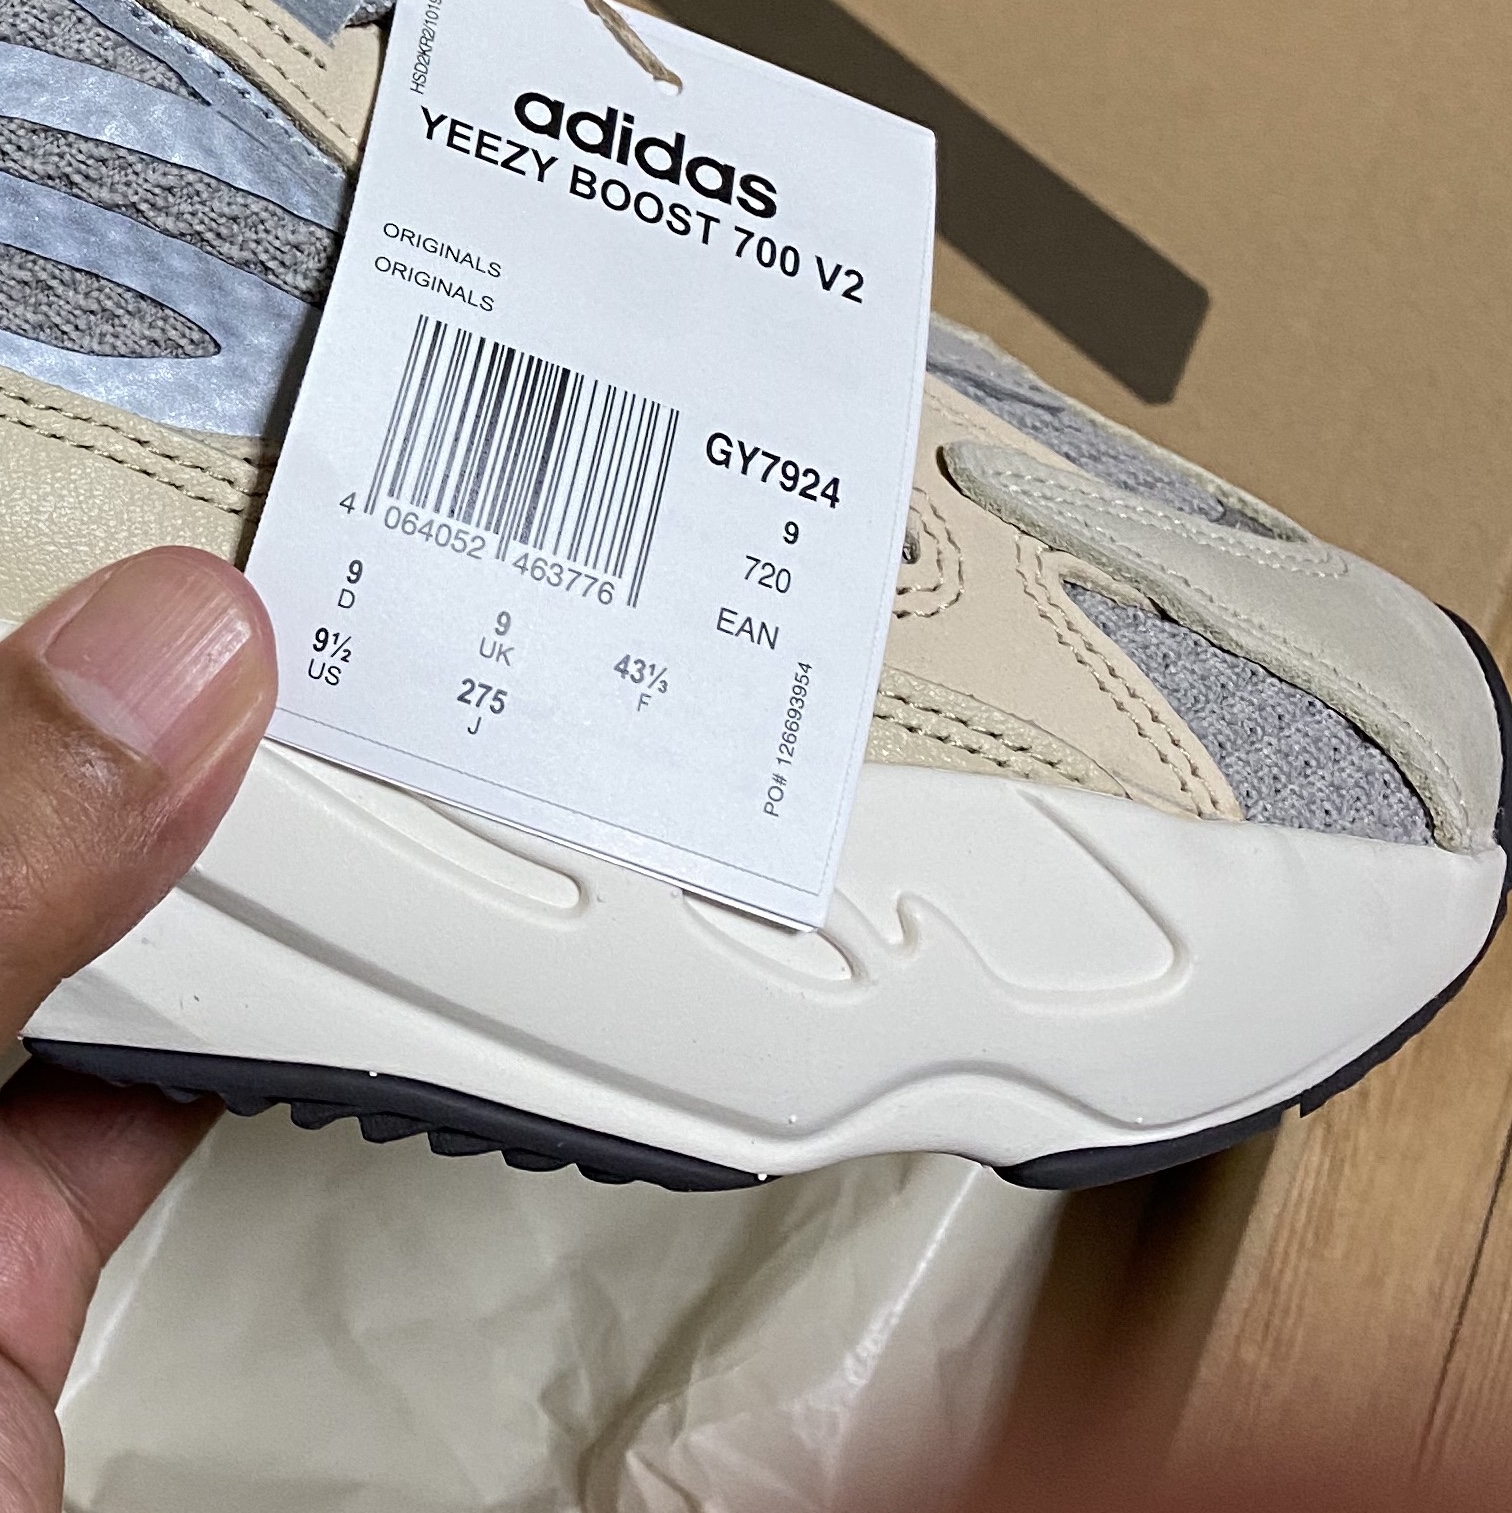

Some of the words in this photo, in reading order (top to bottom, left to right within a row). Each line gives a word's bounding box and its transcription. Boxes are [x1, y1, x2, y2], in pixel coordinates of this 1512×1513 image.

[513, 91, 778, 219] adidas
[420, 104, 560, 184] YEEZY
[568, 163, 721, 246] BOOST
[734, 225, 801, 278] 700
[814, 254, 865, 305] V2
[382, 222, 502, 279] ORIGINALS
[374, 255, 495, 312] ORIGINALS
[705, 431, 841, 510] GY7924
[338, 491, 357, 515] 4
[383, 505, 486, 560] 064052
[511, 552, 616, 606] 463776
[782, 520, 800, 546] 9
[345, 559, 364, 585] 9
[743, 554, 792, 594] 720
[336, 587, 356, 610] D
[494, 610, 512, 637] 9
[716, 606, 780, 651] EAN
[479, 637, 515, 667] UK
[307, 657, 343, 687] US
[456, 678, 509, 715] 275
[636, 693, 652, 712] F
[466, 716, 483, 736] J
[762, 772, 788, 818] PO#
[775, 661, 813, 766] 126693954
